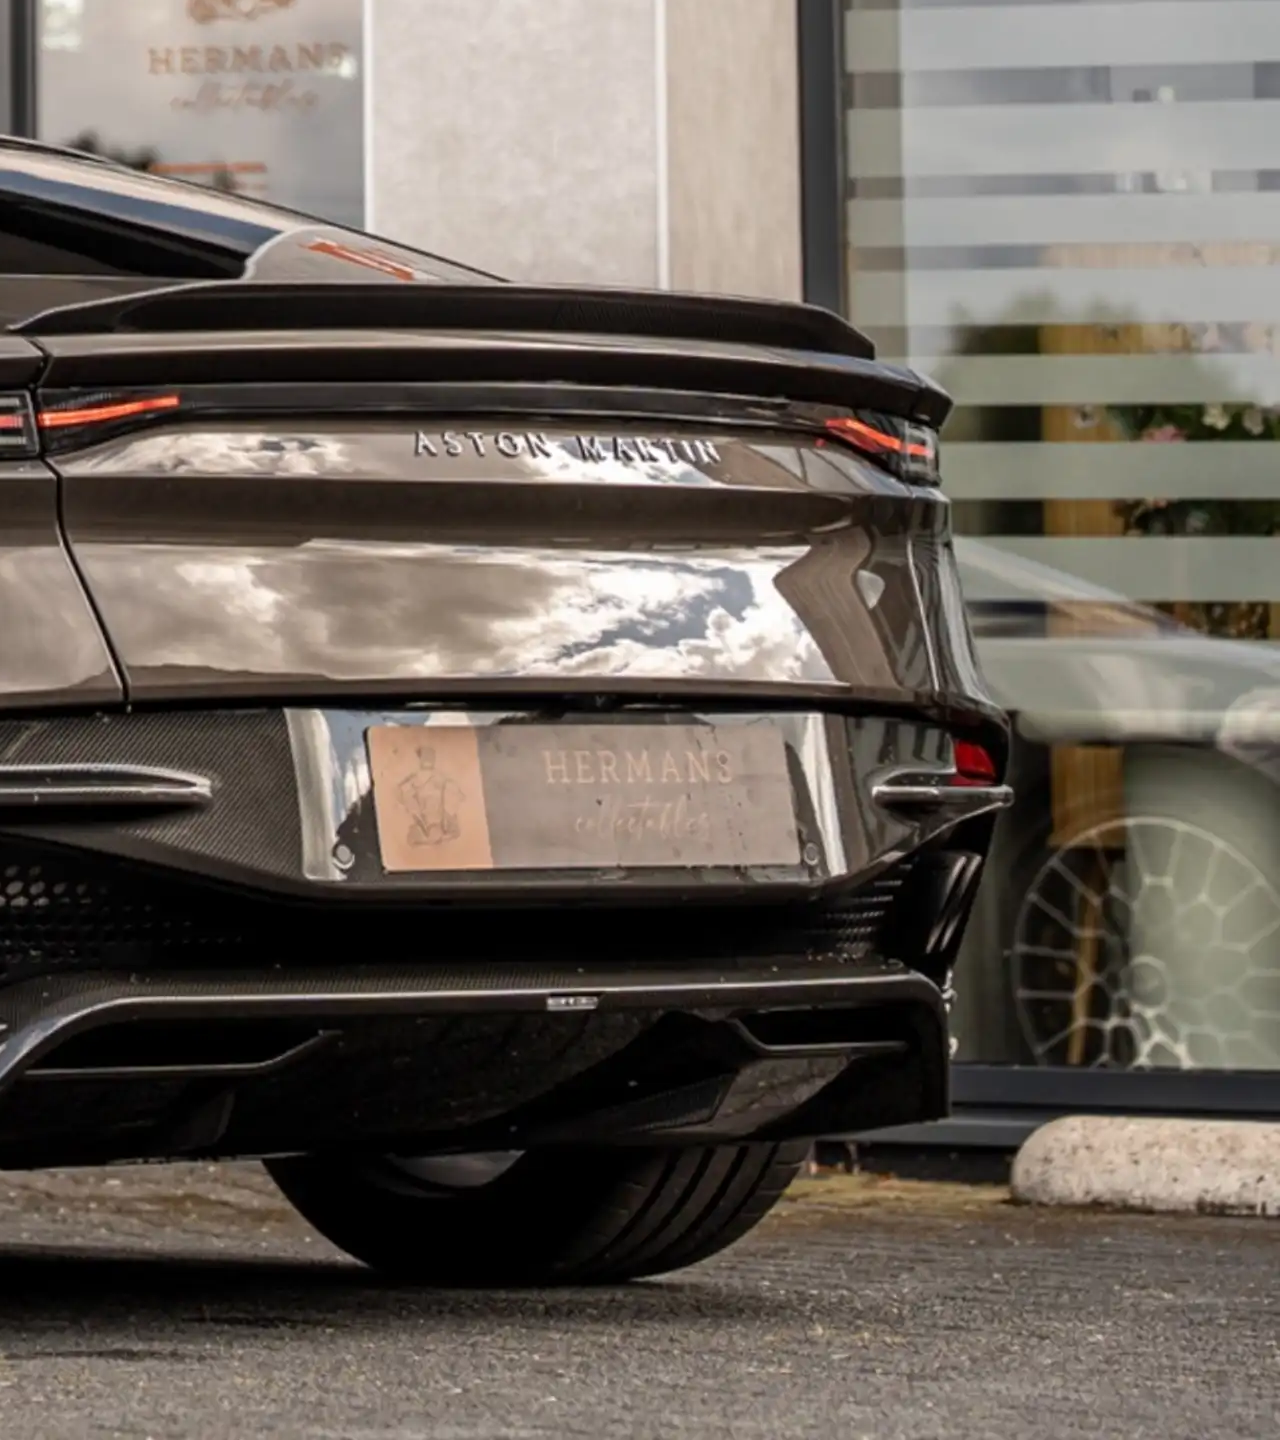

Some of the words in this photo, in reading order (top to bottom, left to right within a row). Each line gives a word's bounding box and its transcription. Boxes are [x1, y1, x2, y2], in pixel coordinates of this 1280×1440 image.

[414, 430, 553, 459] ASTON
[576, 434, 723, 465] MARTIN
[542, 749, 734, 784] HERMANS
